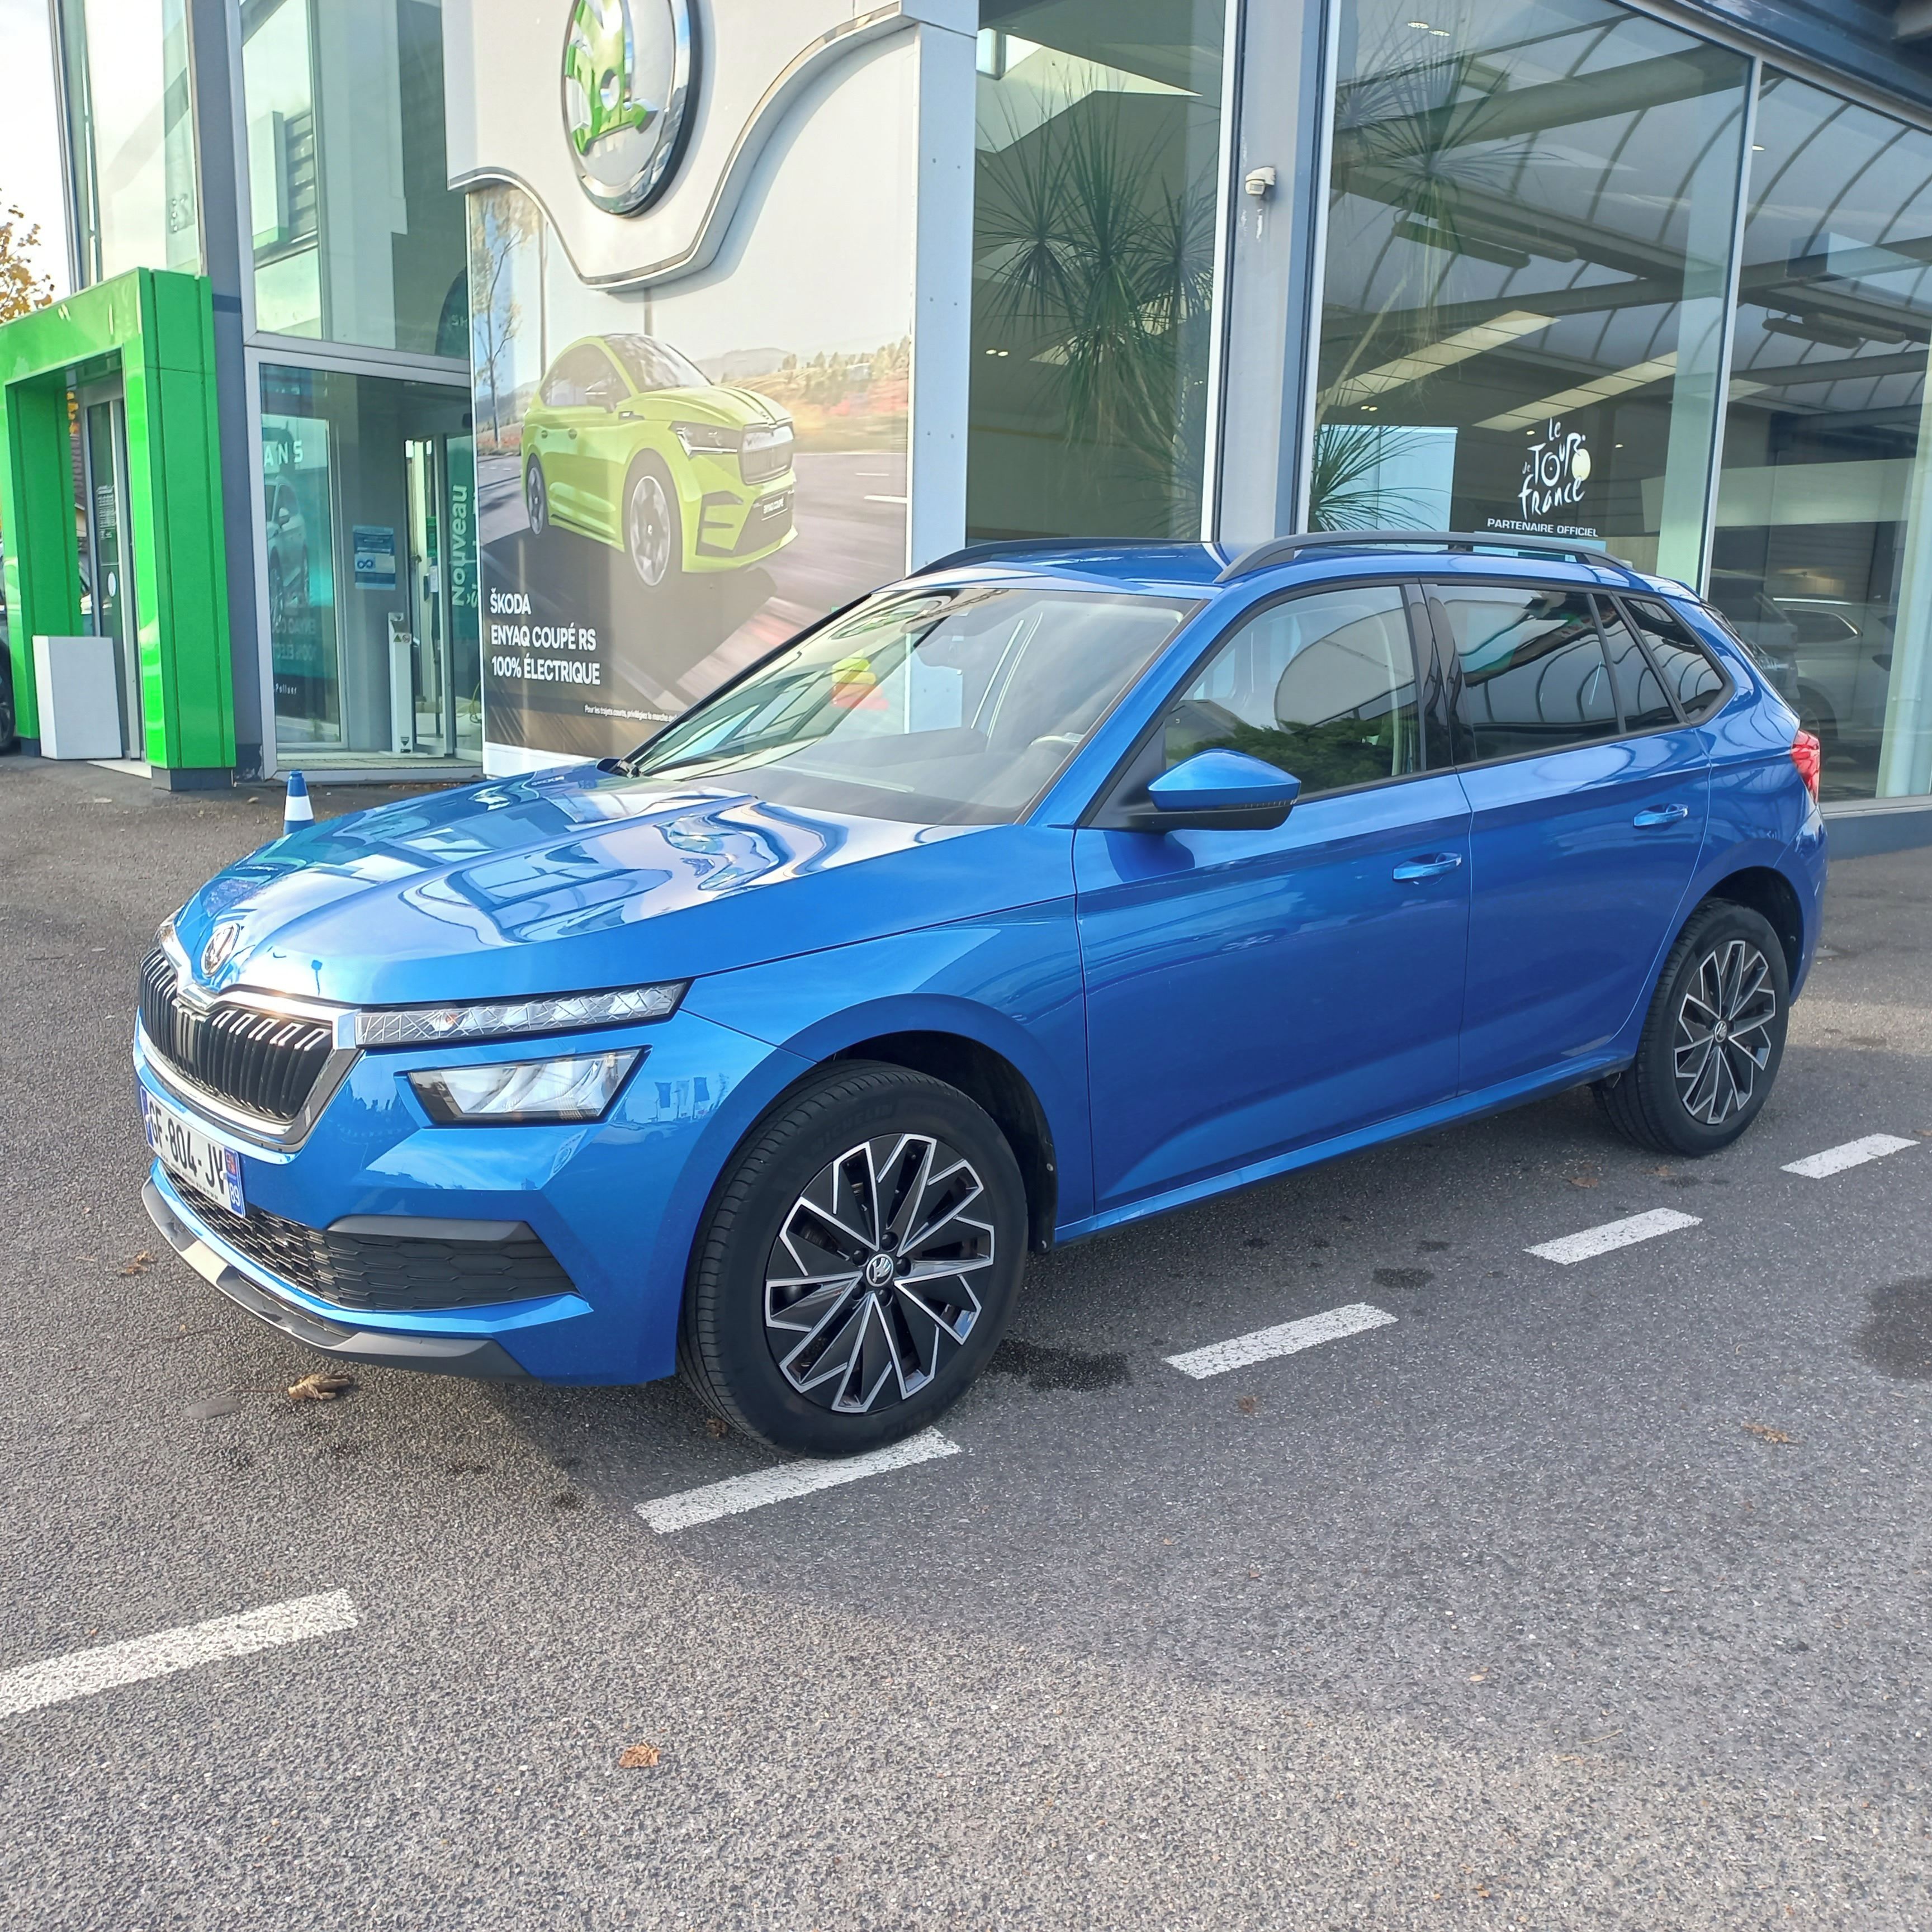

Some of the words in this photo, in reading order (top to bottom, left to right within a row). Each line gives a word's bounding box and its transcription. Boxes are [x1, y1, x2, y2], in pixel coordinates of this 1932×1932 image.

[1487, 518, 1554, 533] PARTENAIRE
[1556, 525, 1599, 537] OFFICIEL
[452, 484, 467, 607] Nouveau
[490, 588, 532, 615] ŠKODA
[490, 624, 531, 647] ENYAQ
[532, 622, 576, 650] COUPÉ
[578, 628, 596, 651] RS
[491, 655, 522, 678] 100%
[523, 652, 601, 685] ÉLECTRIQUE
[229, 1182, 240, 1207] 89
